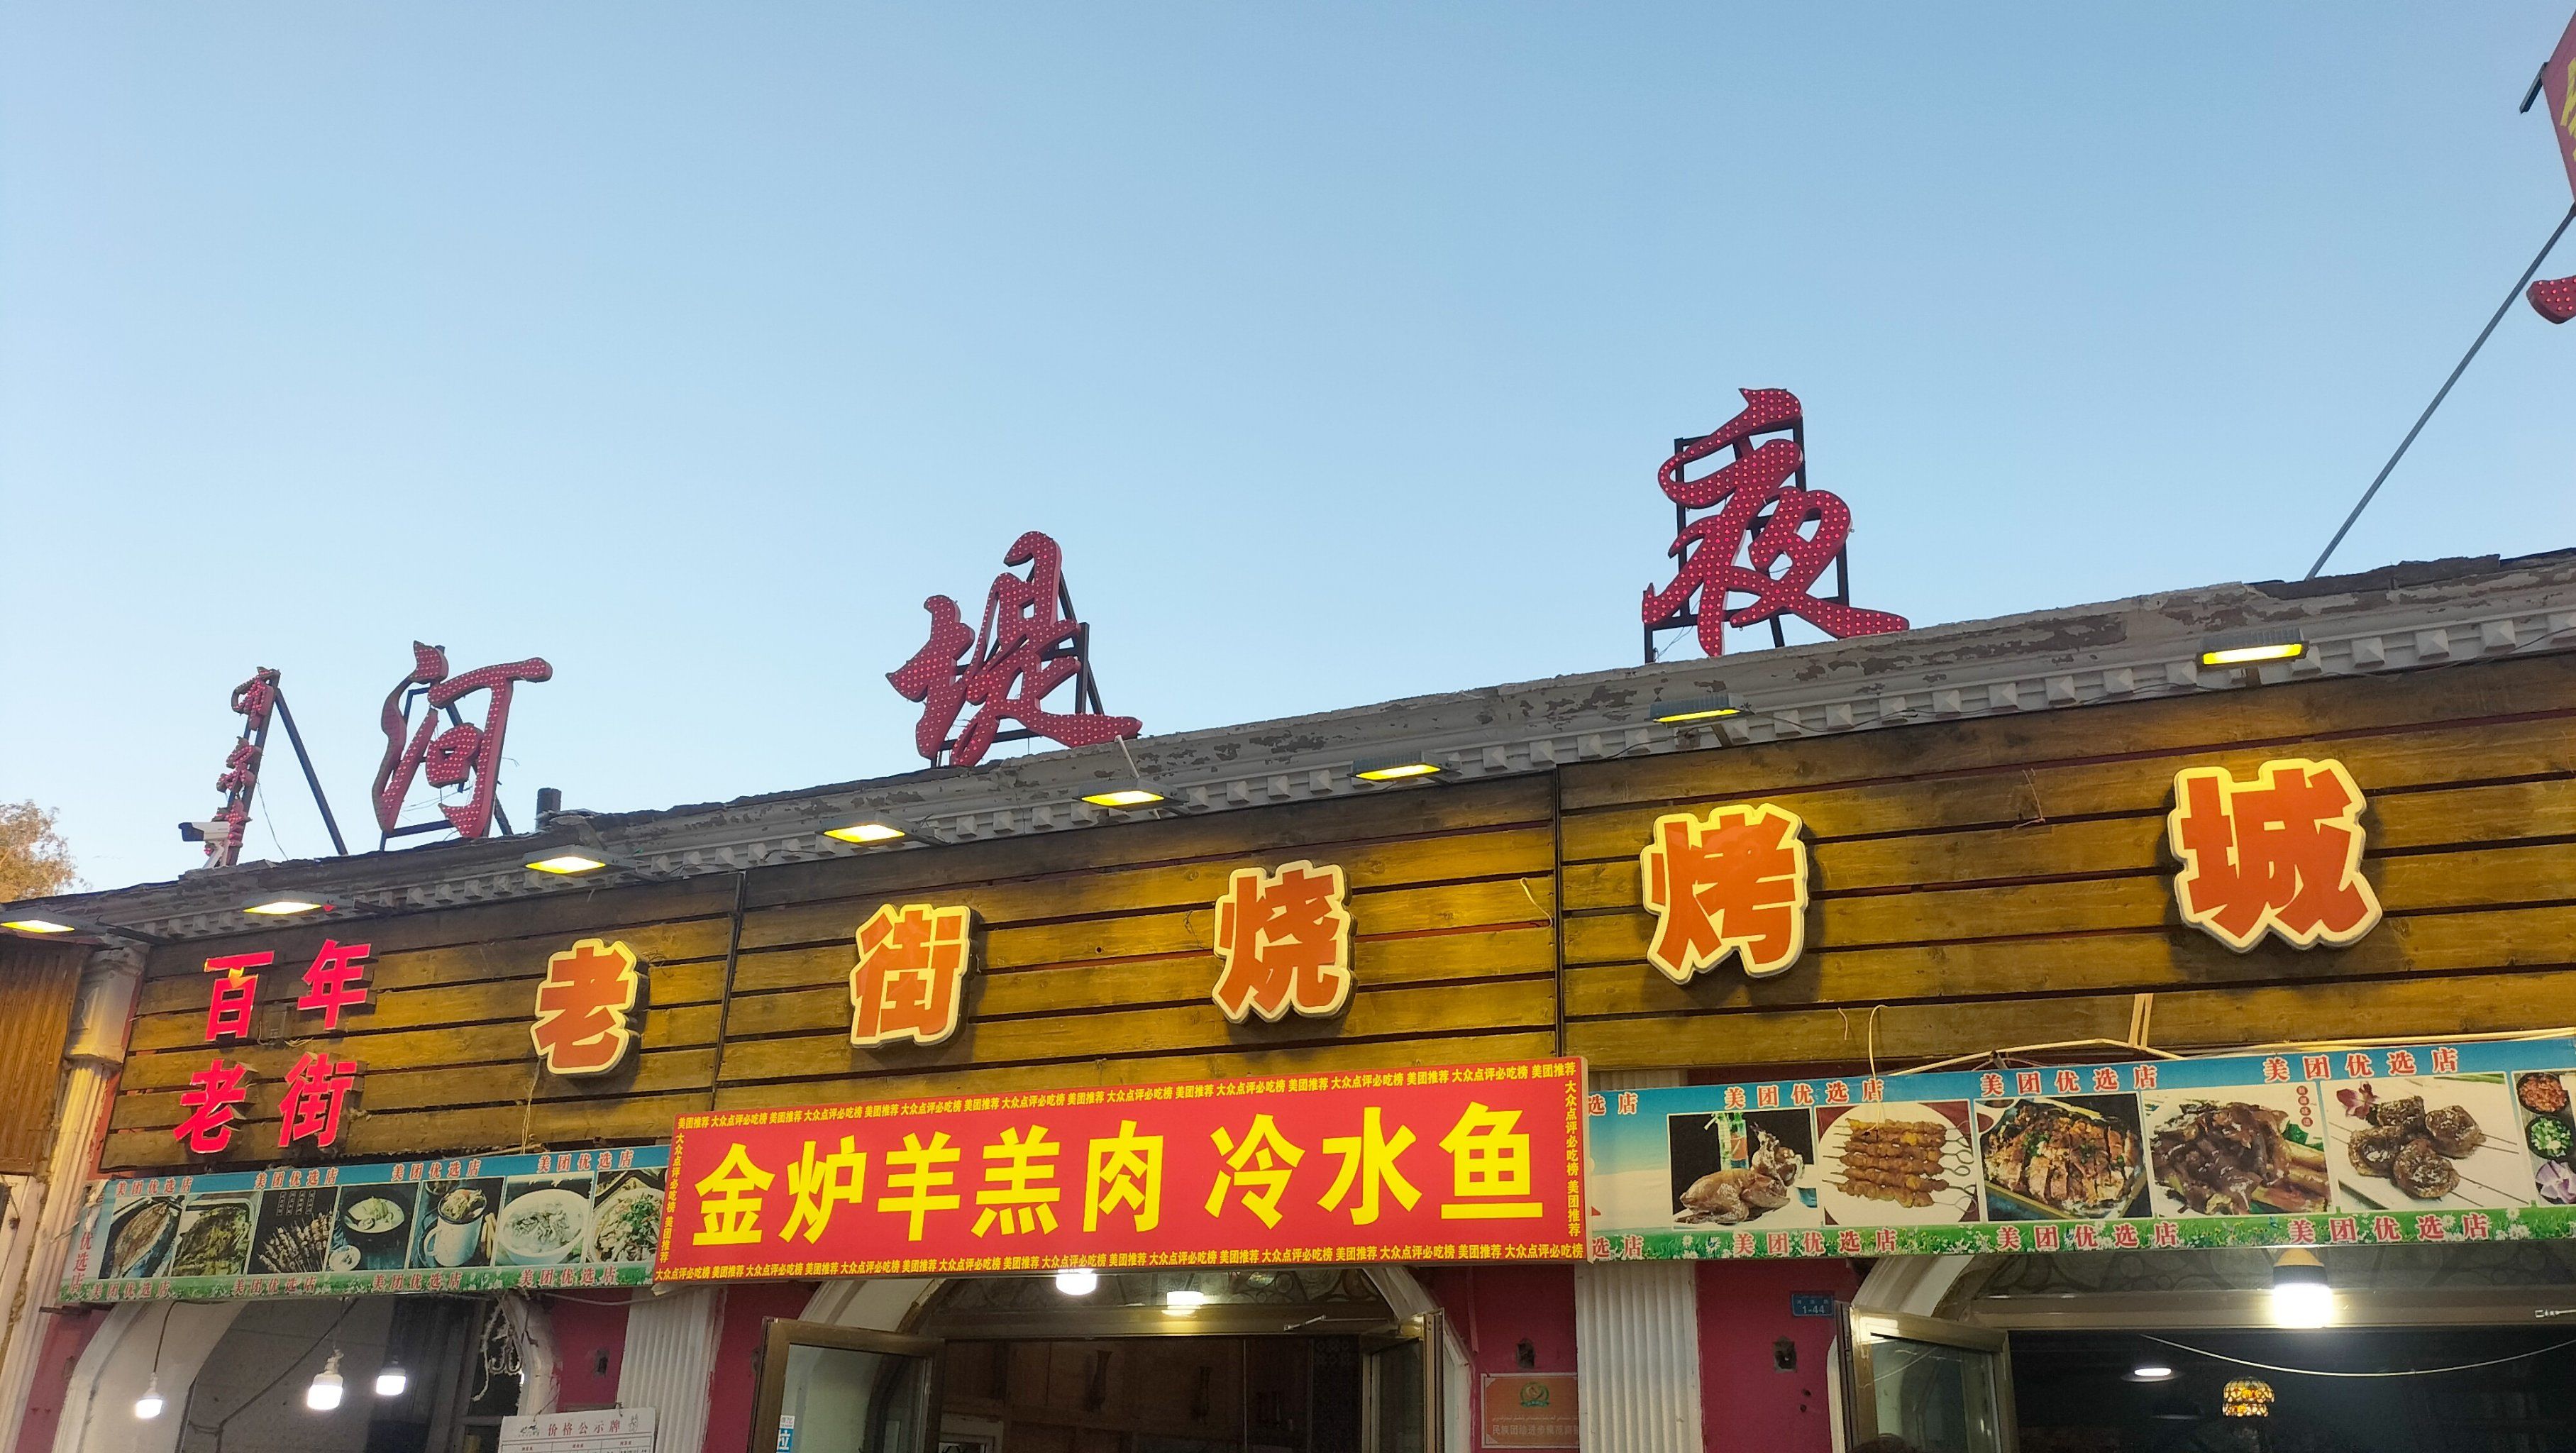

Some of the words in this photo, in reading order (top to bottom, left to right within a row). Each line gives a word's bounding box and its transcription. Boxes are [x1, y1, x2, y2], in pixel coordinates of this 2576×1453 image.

[530, 758, 2382, 1077] 老街烧烤城
[204, 939, 371, 1042] 百年
[2263, 1046, 2458, 1083] 美团优选店
[677, 1115, 711, 1129] 美团推荐
[710, 1112, 768, 1127] 大众点评必吃榜
[769, 1110, 803, 1124] 美团推荐
[803, 1105, 863, 1121] 大众点评必吃榜
[863, 1104, 900, 1117] 美团推荐
[900, 1100, 963, 1115] 大众点评必吃榜
[963, 1097, 1000, 1111] 美团推荐
[1001, 1093, 1066, 1109] 大众点评必吃榜
[1067, 1090, 1105, 1105] 美团推荐
[1106, 1085, 1174, 1103] 大众点评必吃榜
[1175, 1084, 1215, 1099] 美团推荐
[1216, 1078, 1286, 1096] 大众点评必吃榜
[1288, 1077, 1330, 1092] 美团推荐
[1330, 1072, 1405, 1090] 大众点评必吃榜
[1406, 1069, 1449, 1085] 美团推荐
[1452, 1065, 1529, 1082] 大众点评必吃榜
[1531, 1062, 1576, 1078] 美团推荐
[1724, 1078, 1884, 1110] 美团优选店
[1980, 1066, 2157, 1096] 美团优选店
[172, 1052, 358, 1154] 老街
[1564, 1080, 1579, 1176] 大众点评必吃榜
[391, 1159, 481, 1181] 美团优选店
[537, 1150, 634, 1173] 美团优选店
[665, 1133, 685, 1213] 大众点评必吃榜
[692, 1120, 1163, 1247] 金炉羊羔肉
[1204, 1101, 1543, 1231] 冷水鱼
[116, 1176, 192, 1196] 美团优选店
[254, 1167, 339, 1189] 美团优选店
[1567, 1180, 1581, 1237] 美团推荐
[659, 1215, 673, 1264] 美团推荐
[1732, 1227, 1897, 1255] 美团优选店
[1997, 1222, 2178, 1251] 美团优选店
[2288, 1213, 2490, 1245] 美团优选店
[519, 1266, 617, 1287] 美团优选店
[655, 1266, 711, 1280] 大众点评必吃榜
[710, 1265, 744, 1278] 美团推荐
[746, 1263, 805, 1276] 大众点评必吃榜
[805, 1262, 839, 1276] 美团推荐
[839, 1260, 901, 1274] 大众点评必吃榜
[902, 1259, 938, 1273] 美团推荐
[938, 1257, 1002, 1271] 大众点评必吃榜
[1002, 1256, 1041, 1272] 美团推荐
[1042, 1254, 1107, 1272] 大众点评必吃榜
[1109, 1253, 1147, 1268] 美团推荐
[1149, 1252, 1218, 1266] 大众点评必吃榜
[1220, 1250, 1259, 1264] 美团推荐
[1262, 1248, 1334, 1263] 大众点评必吃榜
[1335, 1247, 1377, 1261] 美团推荐
[1380, 1245, 1456, 1259] 大众点评必吃榜
[1458, 1244, 1502, 1259] 美团推荐
[1504, 1243, 1583, 1259] 大众点评必吃榜
[92, 1281, 170, 1298] 美团优选店
[233, 1276, 317, 1295] 美团优选店
[372, 1271, 463, 1291] 美团优选店
[1802, 1305, 1825, 1314] 1-44
[548, 1419, 621, 1437] 价格公示牌
